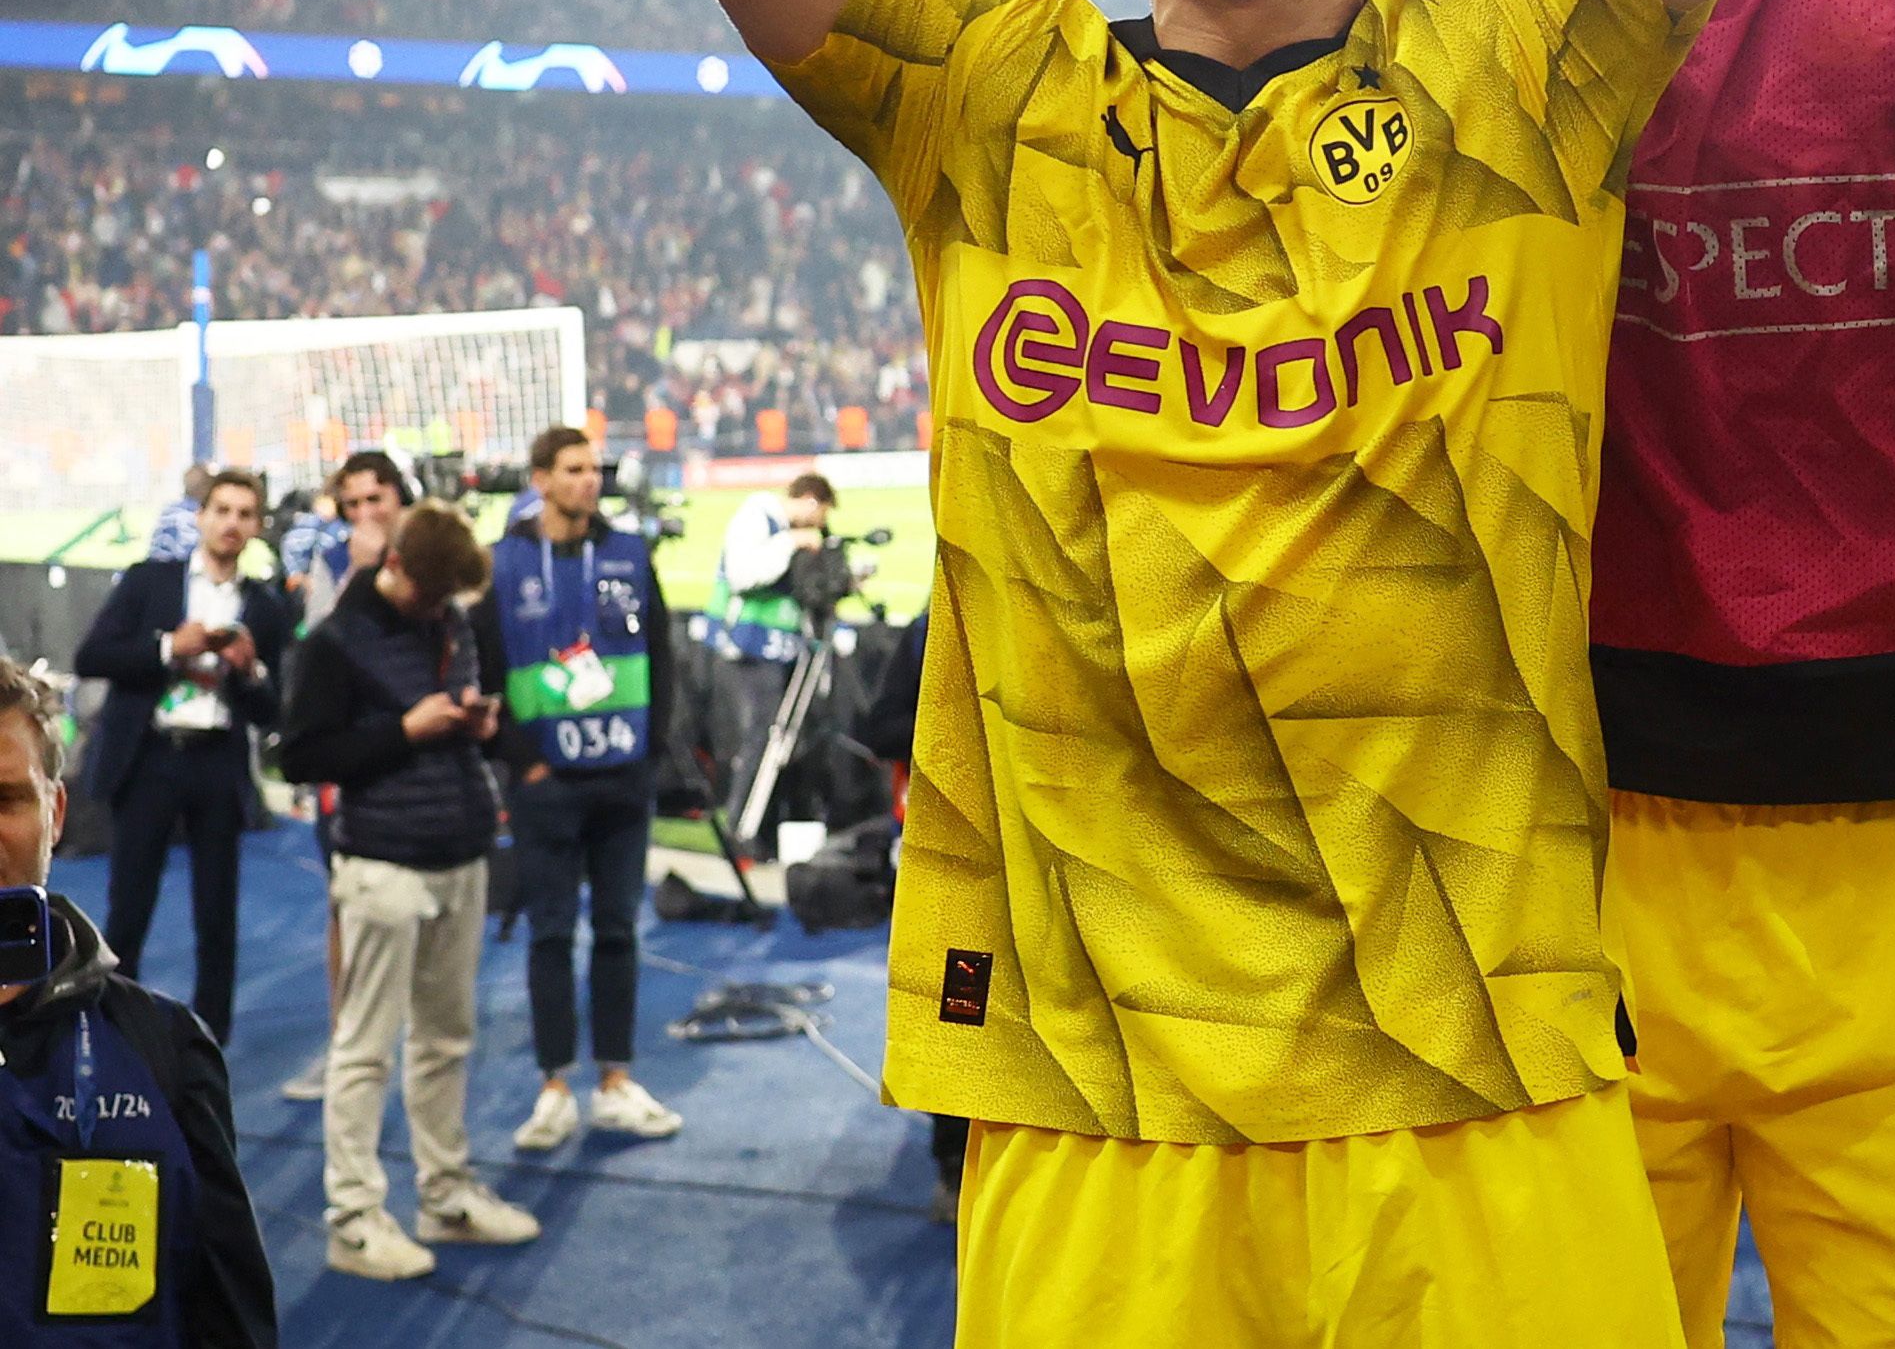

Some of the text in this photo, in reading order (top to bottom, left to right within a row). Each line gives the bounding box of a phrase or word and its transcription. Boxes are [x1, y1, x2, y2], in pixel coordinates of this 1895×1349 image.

[1321, 108, 1408, 186] BVB
[1363, 162, 1394, 194] 09
[1087, 274, 1504, 429] EVONIK
[54, 1093, 151, 1122] 201/24
[82, 1220, 138, 1245] CLUB
[73, 1247, 140, 1270] MEDIA
